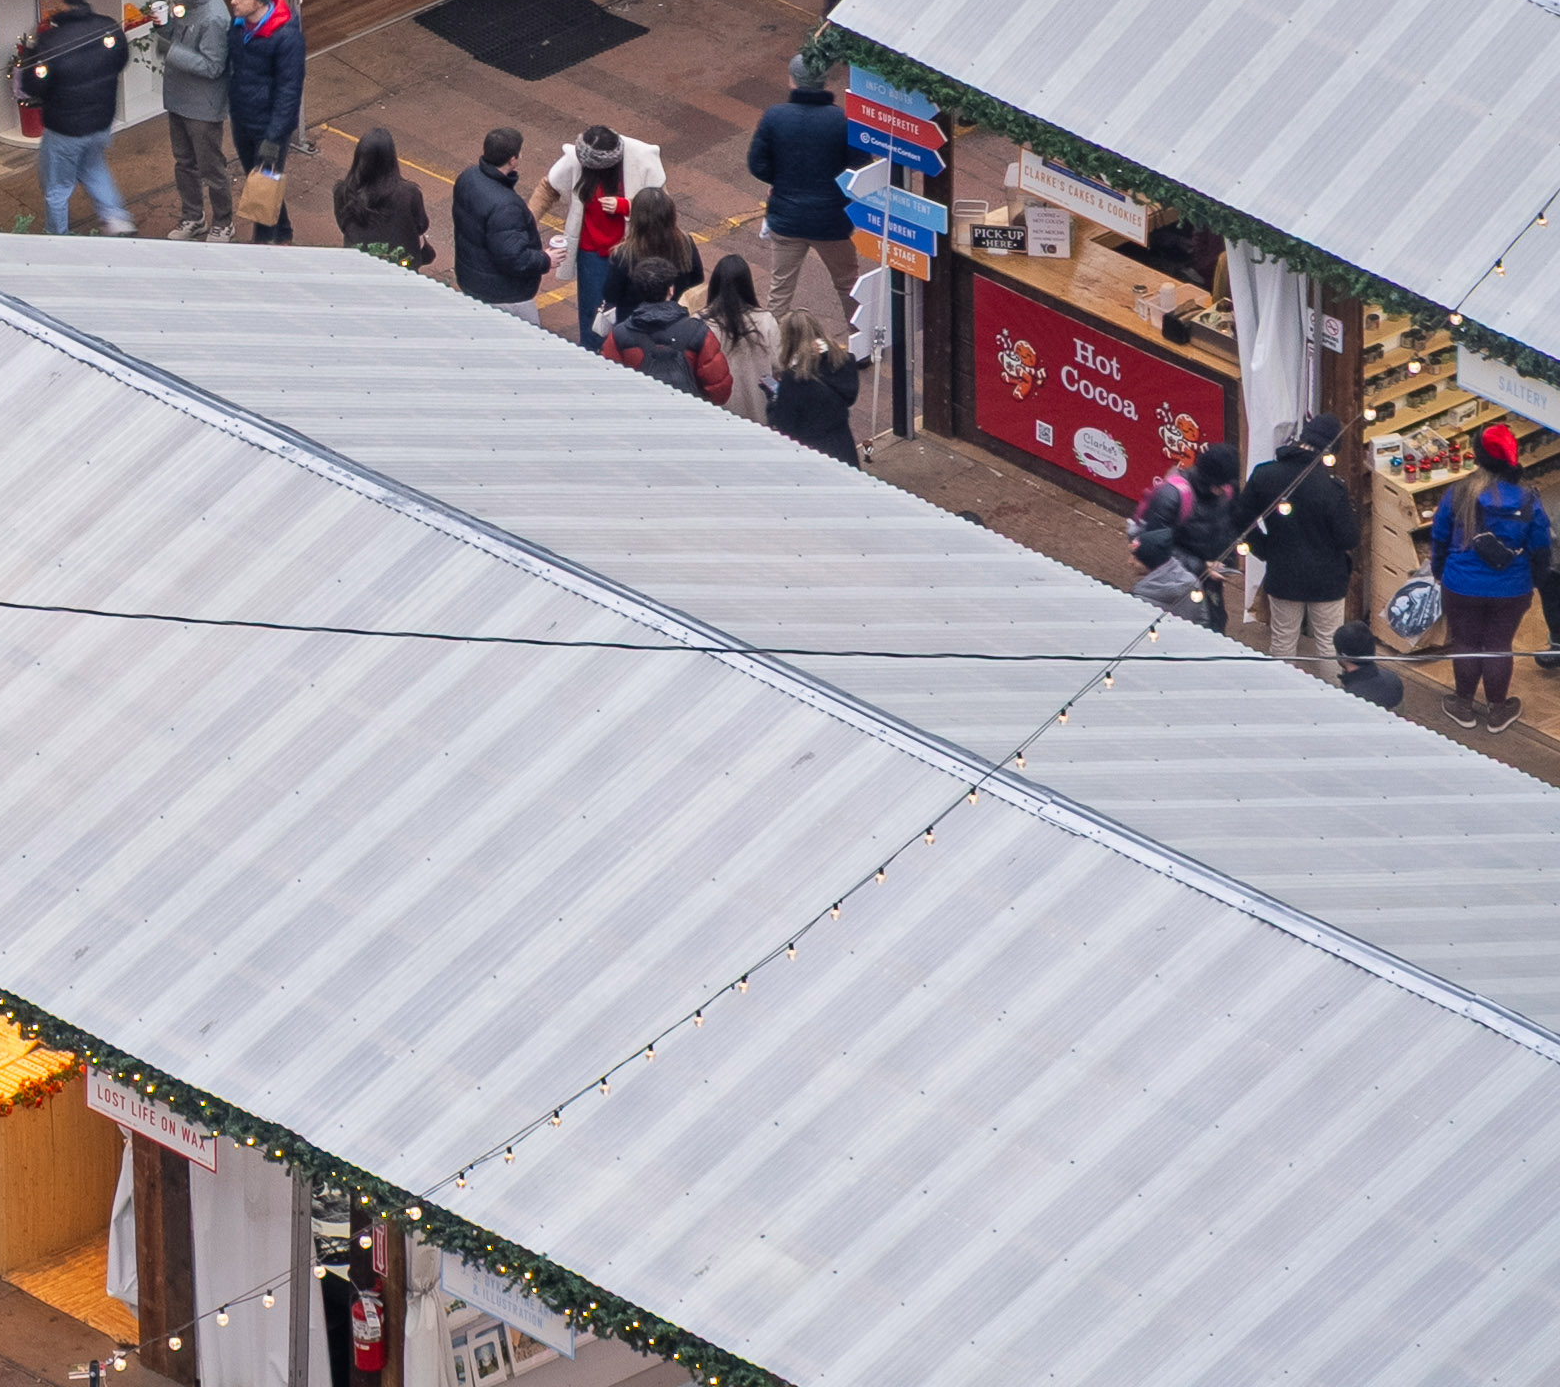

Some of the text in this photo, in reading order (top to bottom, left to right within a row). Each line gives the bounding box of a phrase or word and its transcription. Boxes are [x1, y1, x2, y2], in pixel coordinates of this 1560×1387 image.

[861, 104, 920, 136] THE SUPERETTE
[1024, 164, 1143, 229] CLARKE'S CAKES & COOKIES
[974, 226, 1025, 242] PICK-UP
[1072, 337, 1122, 381] Hot
[1060, 365, 1139, 422] Cocoa
[1498, 375, 1548, 406] SALTERY
[1083, 432, 1119, 458] Clarke's
[96, 1084, 208, 1153] LOST LIFE ON WAX
